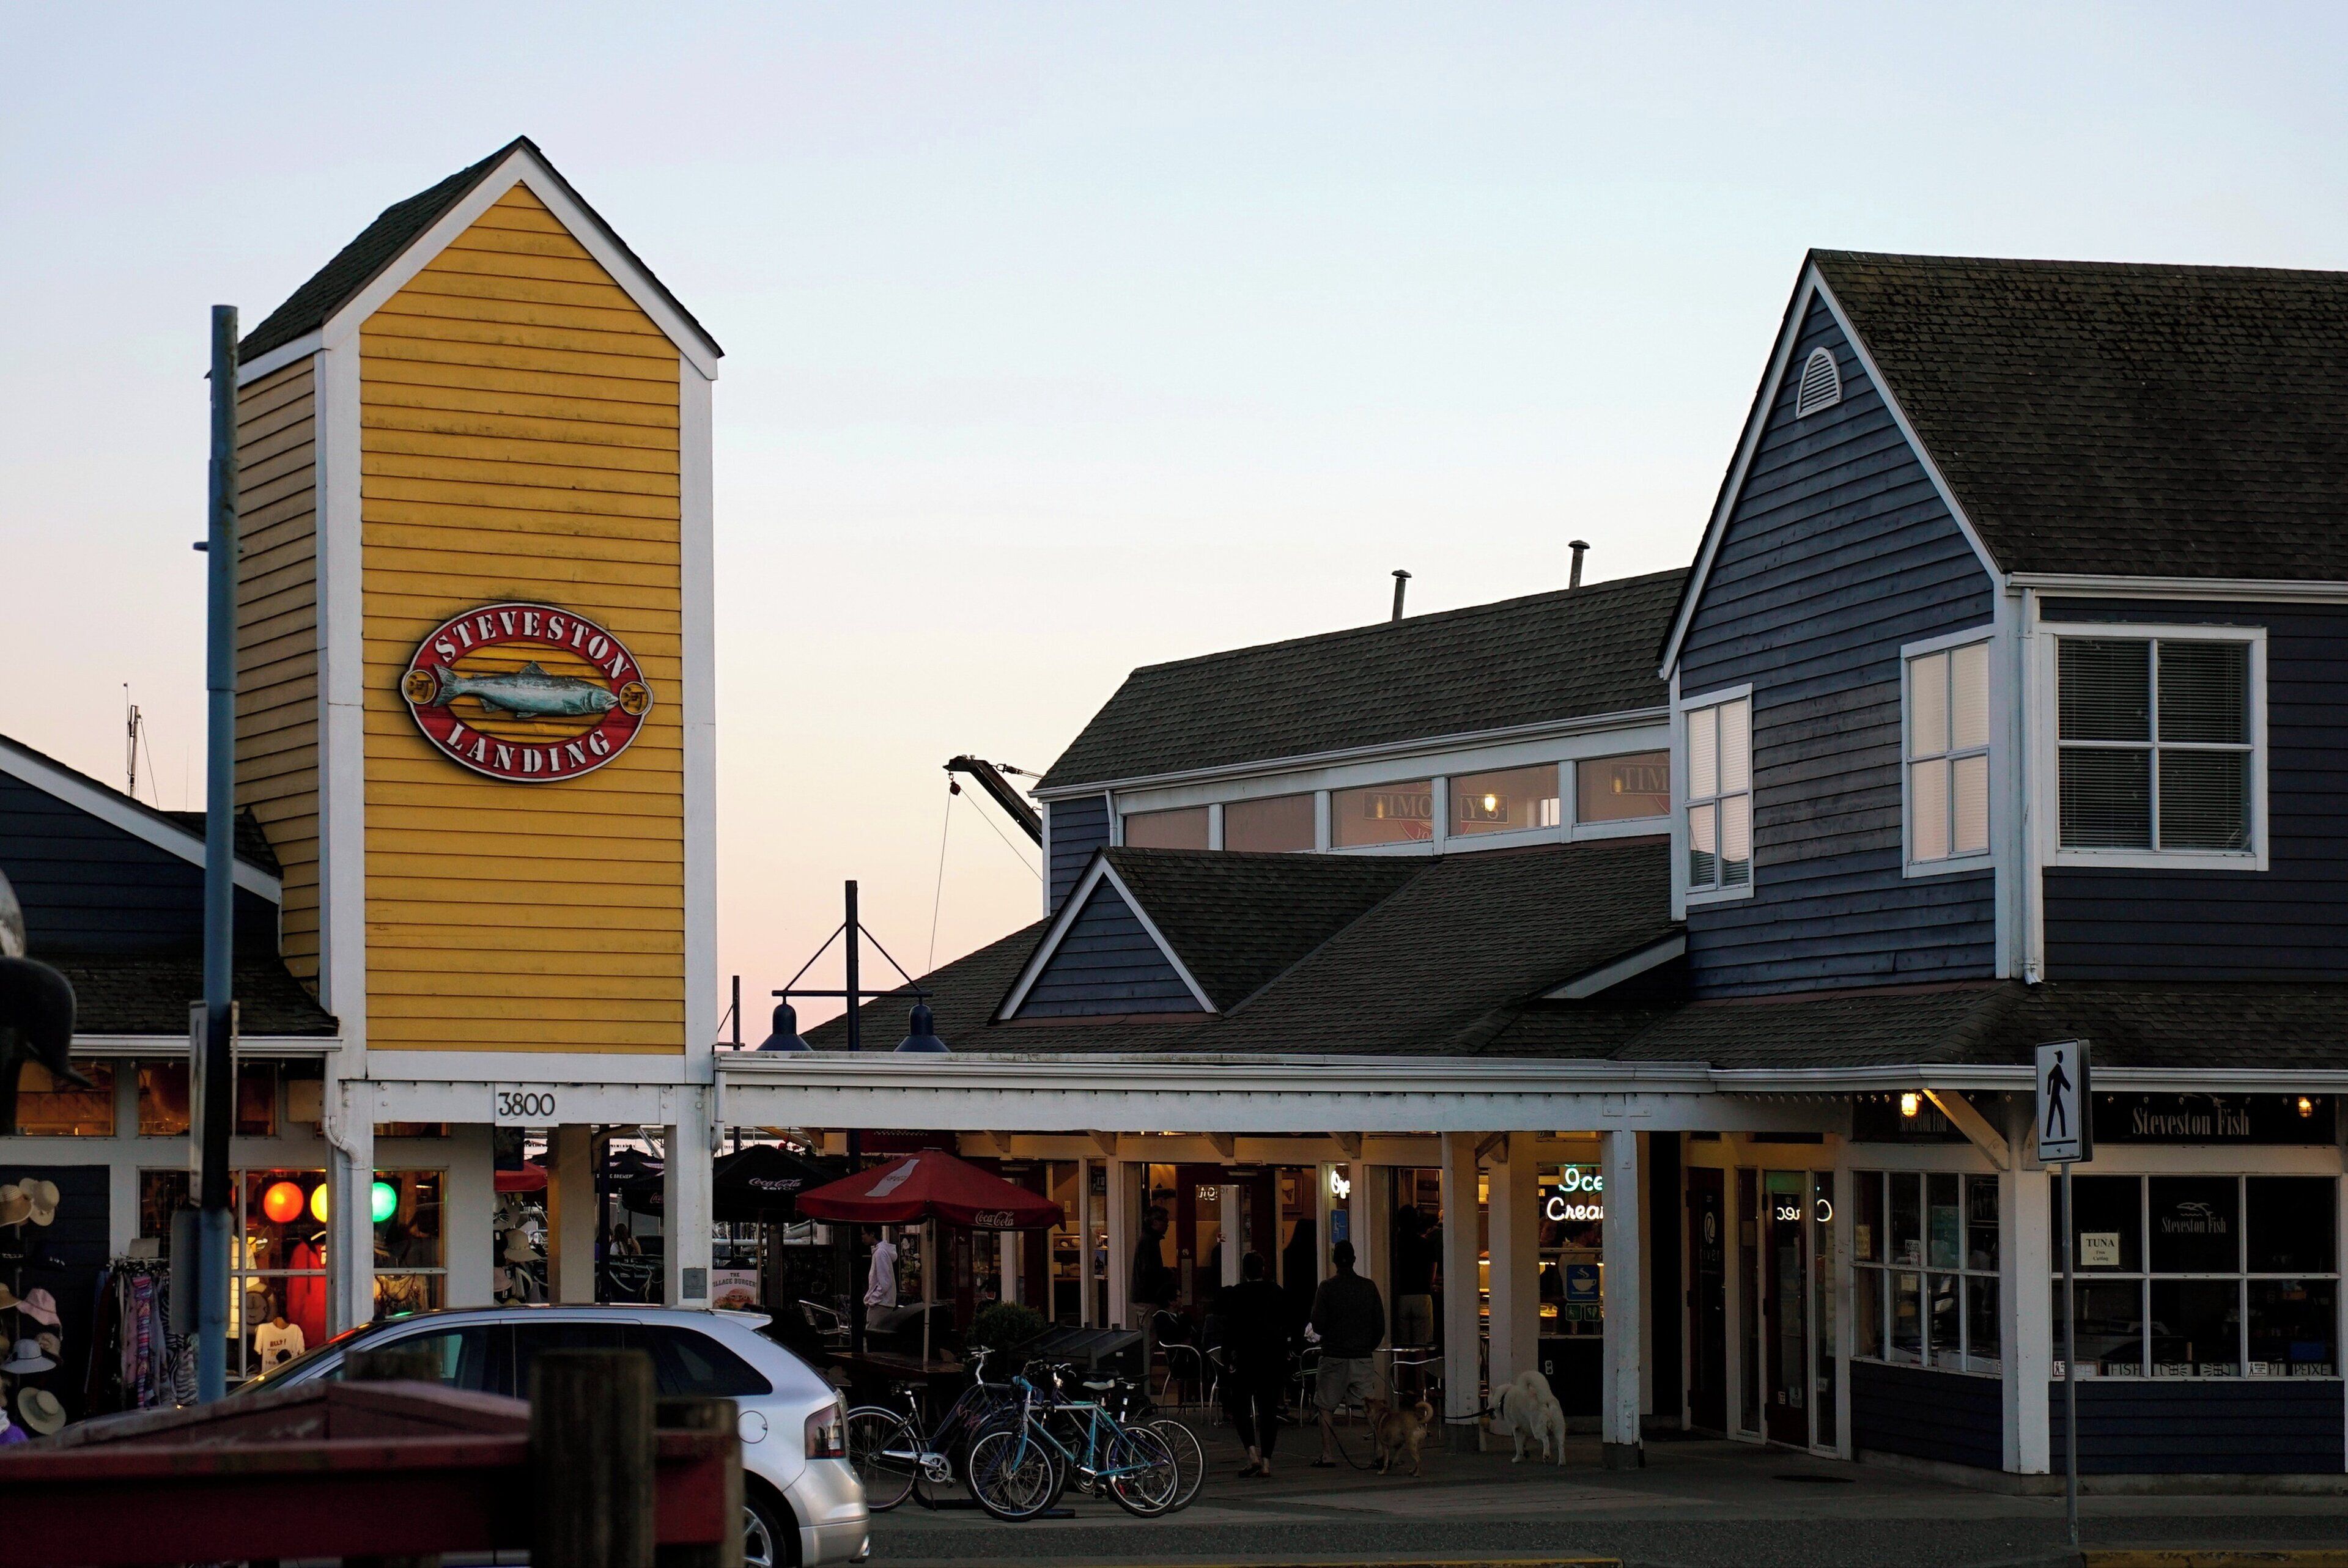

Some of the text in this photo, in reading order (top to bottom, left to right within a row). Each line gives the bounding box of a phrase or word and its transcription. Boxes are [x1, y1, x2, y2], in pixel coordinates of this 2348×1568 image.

[434, 611, 630, 679] STEVESTON
[445, 722, 611, 773] LANDING
[1620, 767, 1669, 791] TIM
[498, 1092, 555, 1116] 3800
[2132, 1106, 2251, 1135] Steveston Fish
[1330, 1169, 1351, 1199] Ope
[1558, 1164, 1603, 1192] Ice
[2162, 1215, 2227, 1234] Steveston Fish
[2086, 1238, 2115, 1248] TUNA
[713, 1278, 756, 1288] ILLAGE BURGER
[2111, 1363, 2142, 1375] FISH
[2294, 1363, 2328, 1376] PEIXE
